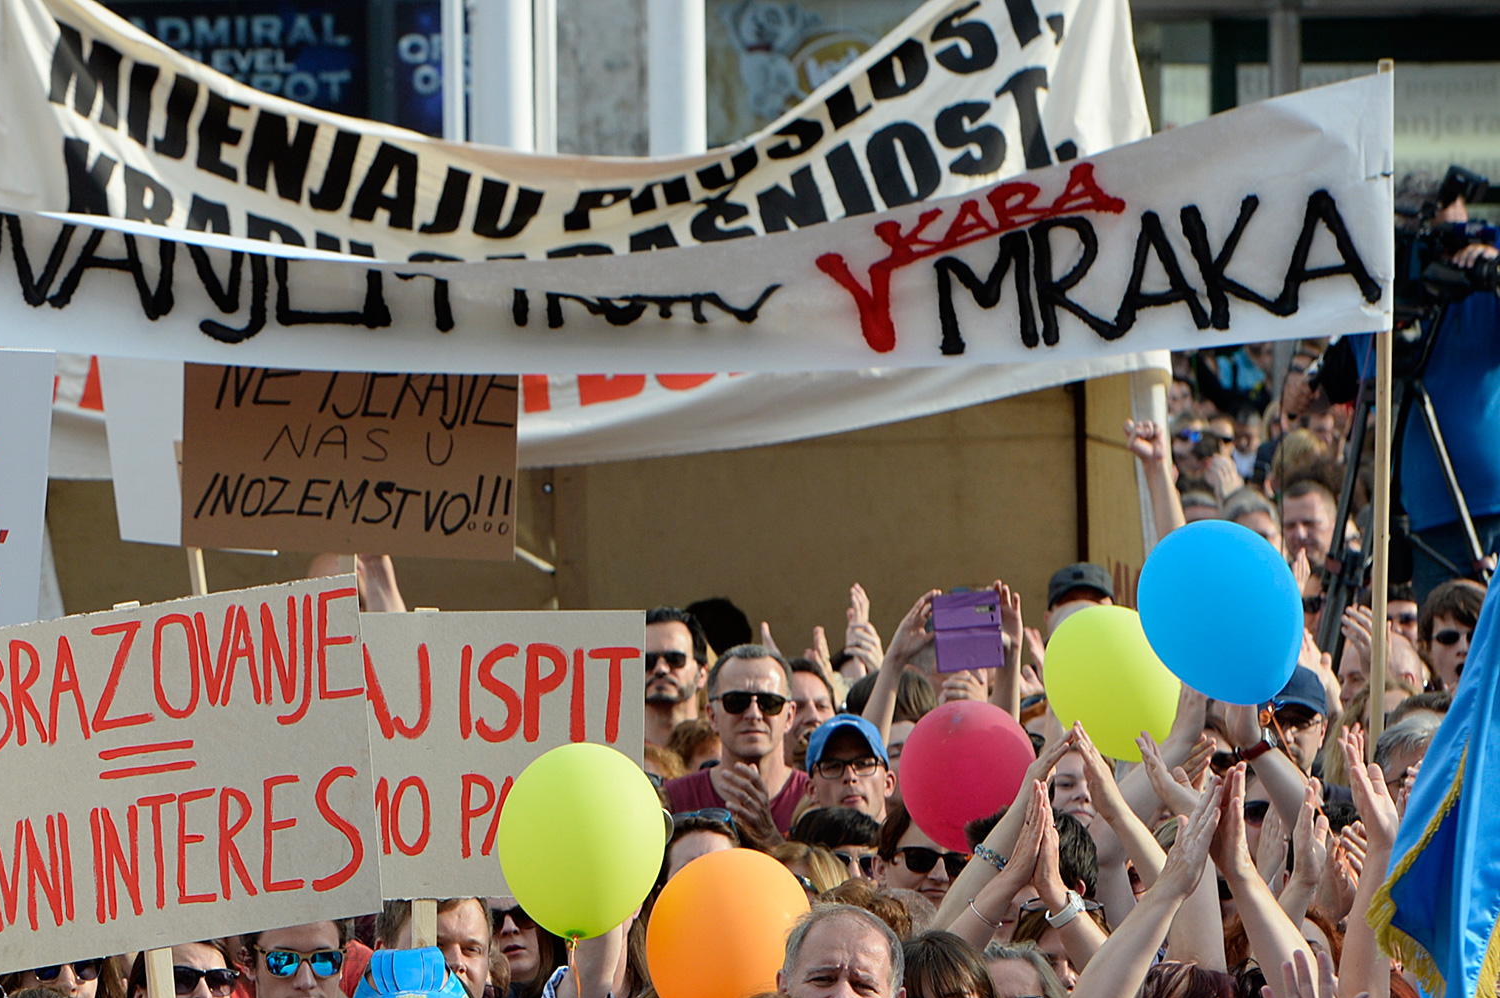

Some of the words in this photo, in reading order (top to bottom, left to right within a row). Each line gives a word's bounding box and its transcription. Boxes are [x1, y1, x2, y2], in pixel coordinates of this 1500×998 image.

[49, 16, 546, 240] MIJENJAJU
[933, 188, 1382, 355] MRAKA
[262, 423, 391, 463] NAS
[426, 431, 463, 466] U
[459, 643, 641, 743] ISPIT
[92, 766, 365, 924] INTERES
